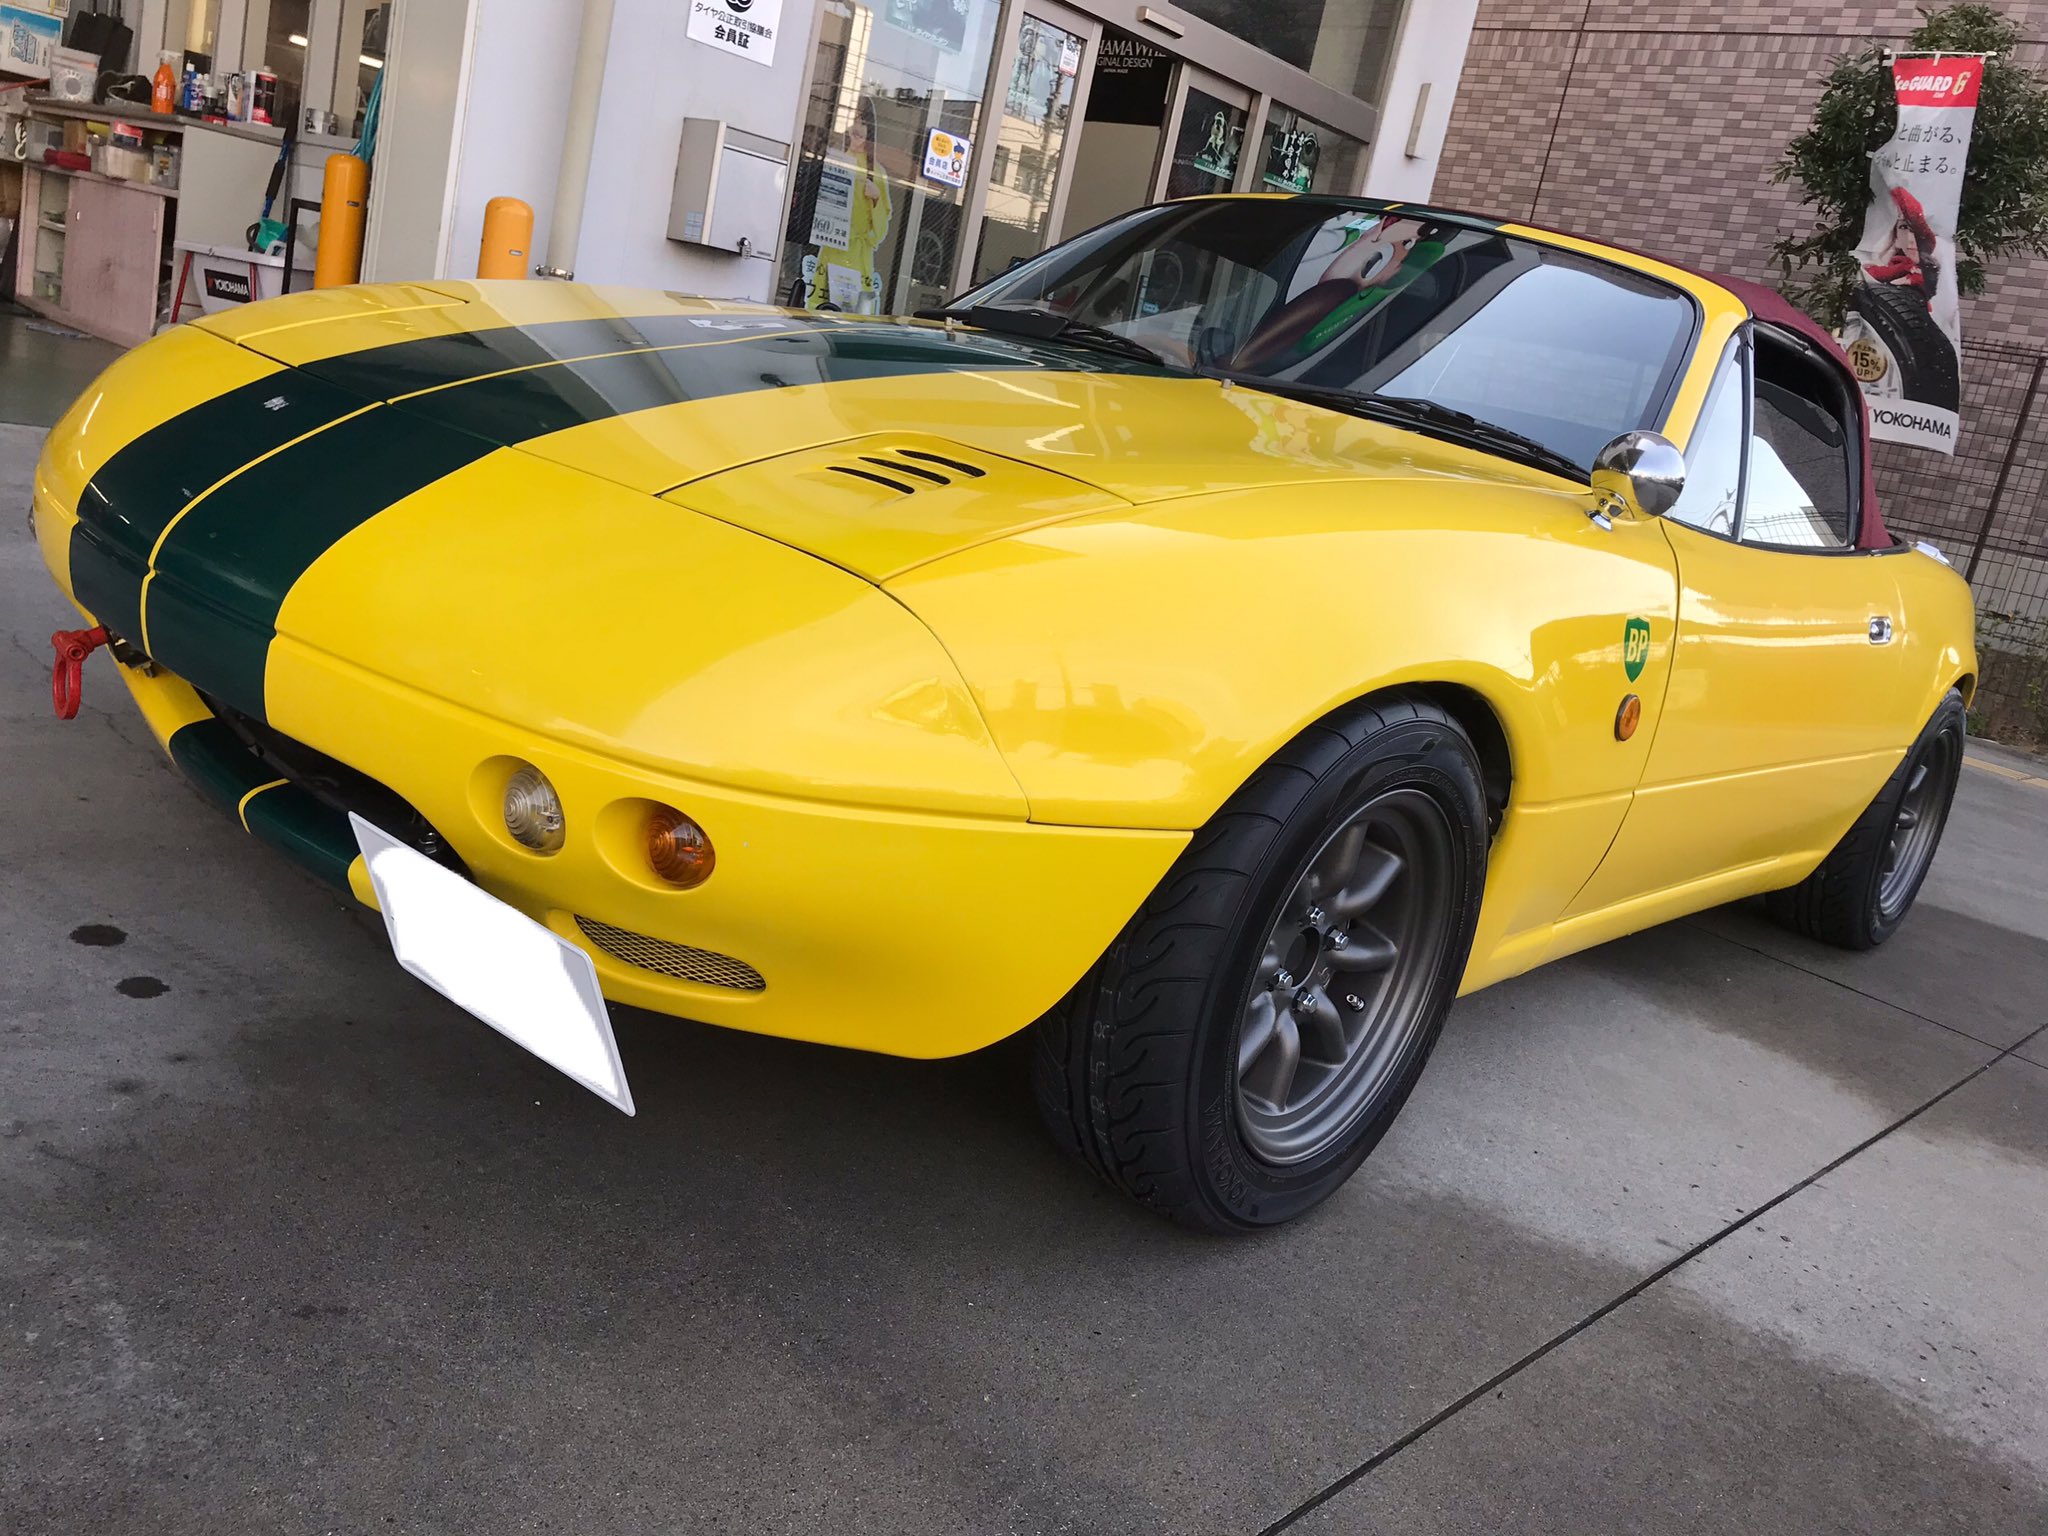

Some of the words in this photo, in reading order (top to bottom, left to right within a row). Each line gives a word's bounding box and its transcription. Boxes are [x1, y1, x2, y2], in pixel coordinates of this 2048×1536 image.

[695, 2, 773, 40] タイヤ公正取引協議会
[714, 24, 751, 49] 会員証
[1122, 57, 1153, 69] DESIGN
[214, 278, 249, 296] YOKOHAMA
[1852, 351, 1881, 372] 15%
[1873, 408, 1952, 439] YOKOHAMA
[1626, 627, 1649, 663] BP
